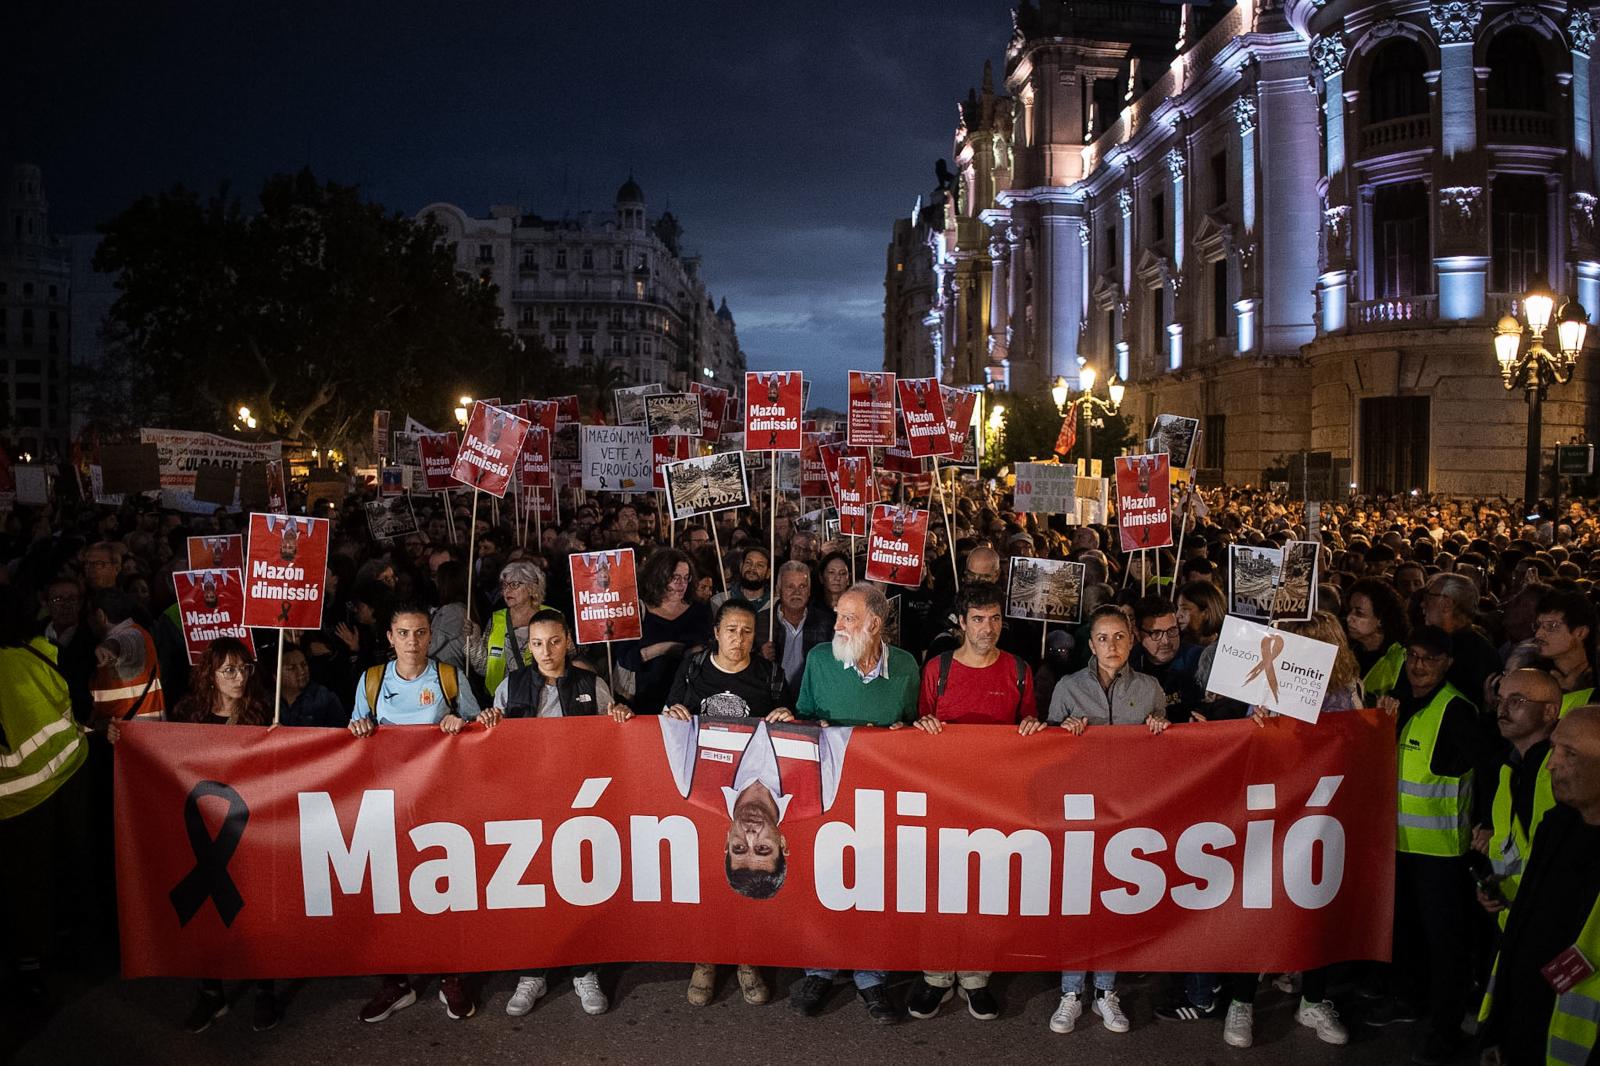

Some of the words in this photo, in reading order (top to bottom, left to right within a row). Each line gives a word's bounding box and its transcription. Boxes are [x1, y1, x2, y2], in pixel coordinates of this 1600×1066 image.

[750, 404, 786, 418] Mazón
[906, 410, 936, 424] Mazón
[750, 418, 798, 431] dimissió
[910, 422, 946, 437] dimissió
[467, 434, 502, 460] Mazón
[601, 447, 628, 461] VETE
[635, 449, 643, 460] A
[460, 450, 509, 477] dimissió
[713, 492, 743, 506] 2024
[1121, 494, 1156, 510] Mazón
[1122, 508, 1168, 527] dimissió
[873, 536, 909, 552] Mazón
[871, 551, 919, 567] dimissió
[252, 560, 304, 580] Mazón
[251, 581, 318, 601] dimissió
[578, 589, 619, 605] Mazón
[186, 608, 230, 626] Mazón
[581, 602, 635, 620] dimissió
[1221, 643, 1260, 661] Mazón
[1280, 681, 1292, 690] un
[1296, 685, 1319, 697] nom
[1294, 676, 1307, 686] no
[298, 777, 700, 917] Mazón
[814, 775, 1345, 916] dimissió
